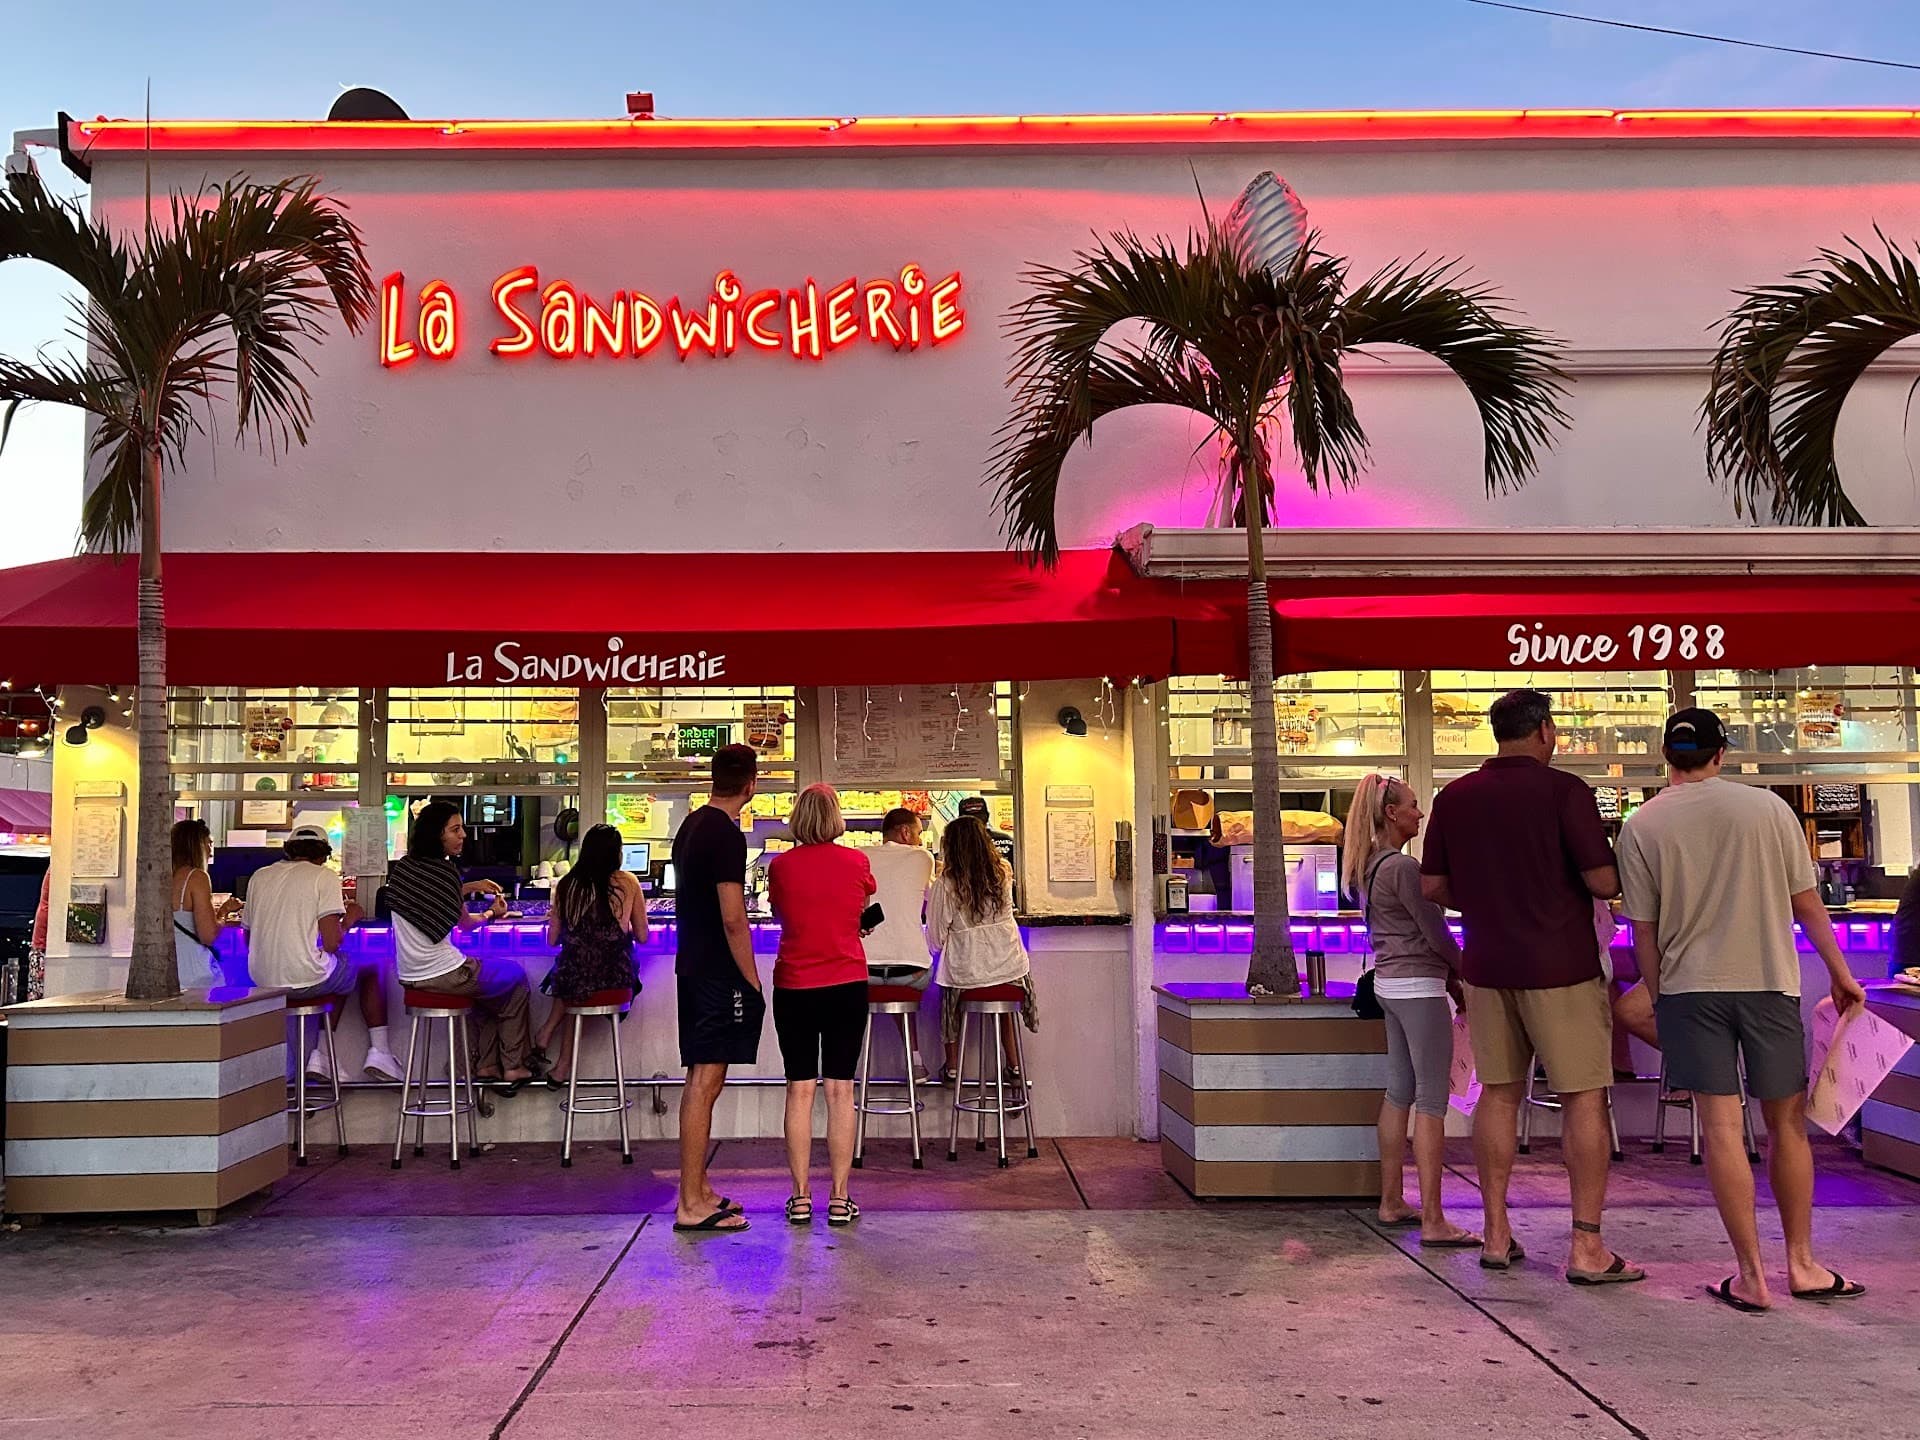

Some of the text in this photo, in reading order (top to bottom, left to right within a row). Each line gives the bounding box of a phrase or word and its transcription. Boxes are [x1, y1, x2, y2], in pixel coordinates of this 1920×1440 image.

[381, 271, 456, 367] La
[1507, 622, 1725, 666] Since 1988
[446, 651, 483, 683] La
[678, 728, 716, 738] ORDER
[681, 738, 711, 749] HERE
